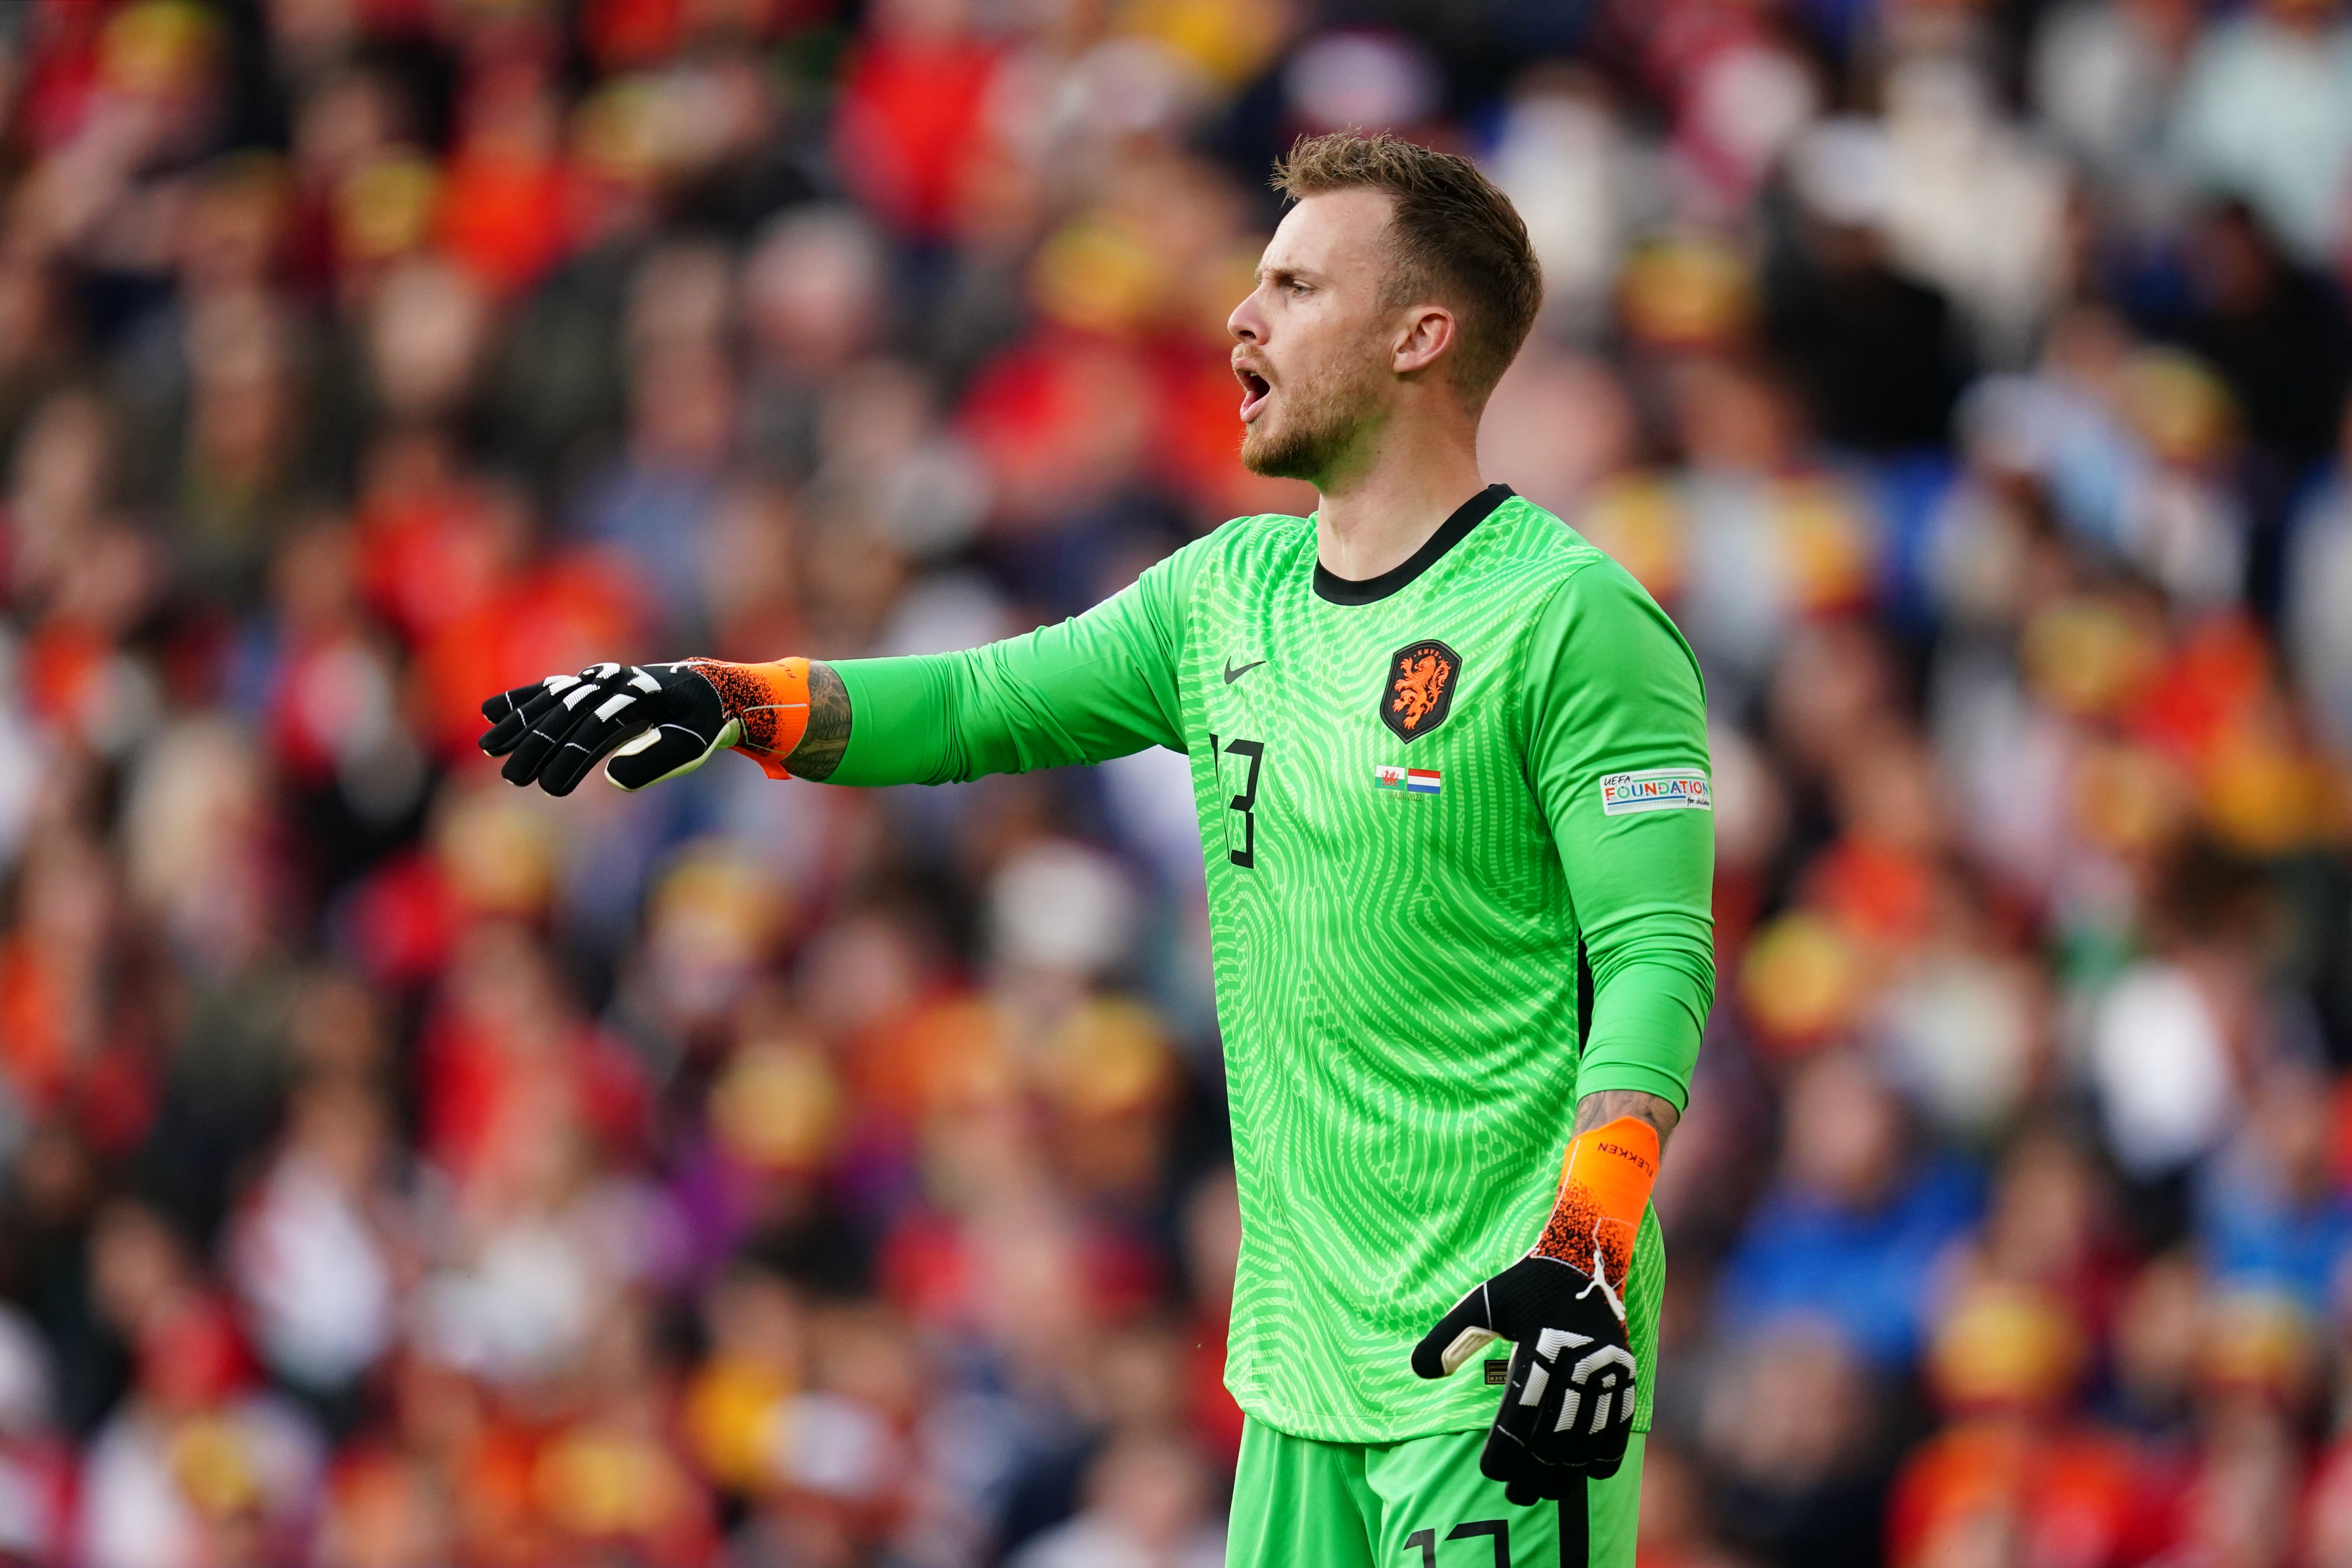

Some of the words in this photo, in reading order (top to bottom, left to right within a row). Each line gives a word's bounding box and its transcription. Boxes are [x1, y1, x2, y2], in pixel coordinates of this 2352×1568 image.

[1418, 649, 1440, 657] KNVB
[1604, 775, 1631, 786] UEFA
[1209, 731, 1264, 869] 3
[1393, 791, 1407, 800] JUNI
[1408, 793, 1422, 802] 2022
[1597, 1142, 1654, 1177] FLEKKEN
